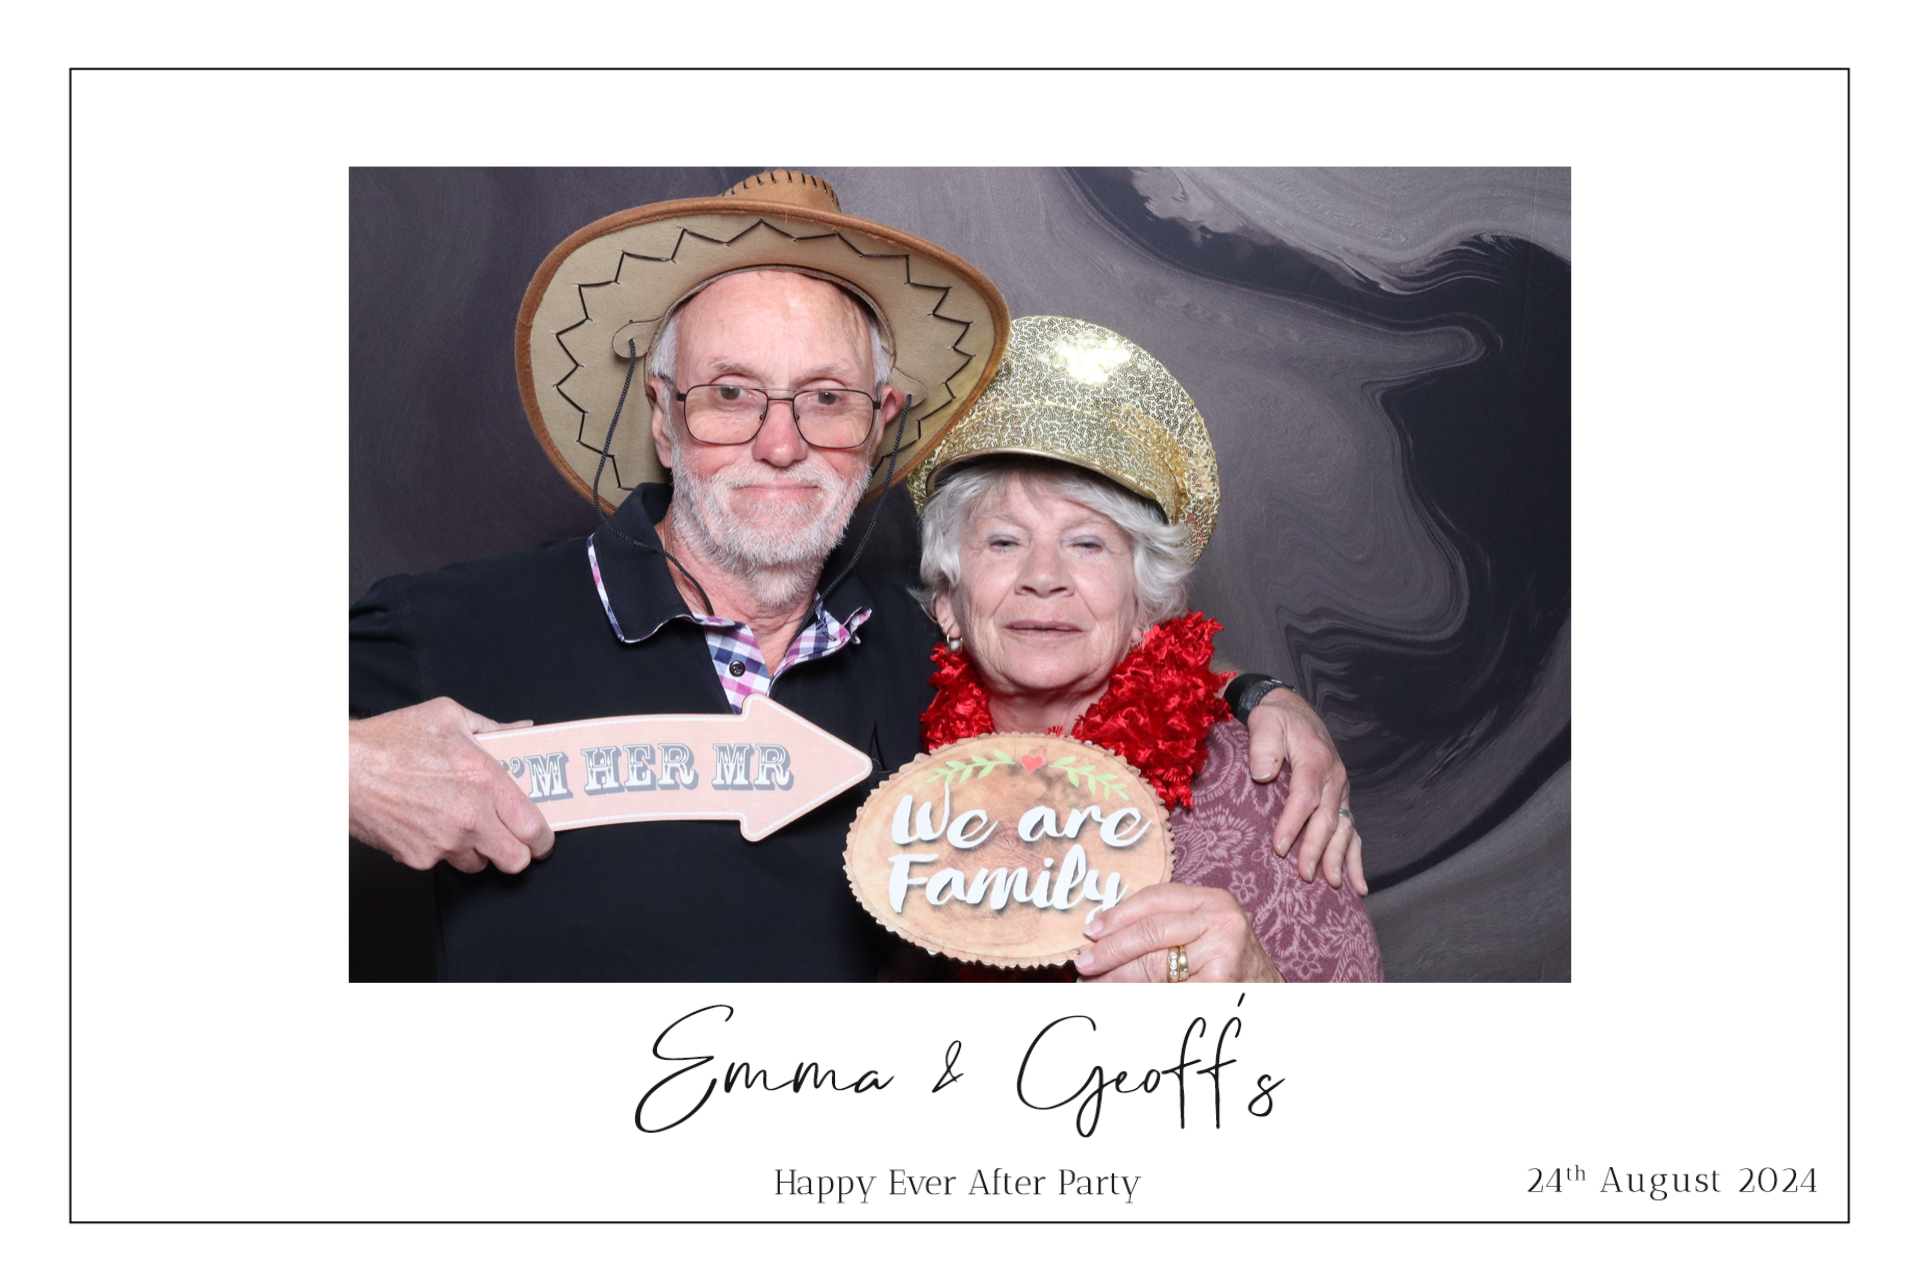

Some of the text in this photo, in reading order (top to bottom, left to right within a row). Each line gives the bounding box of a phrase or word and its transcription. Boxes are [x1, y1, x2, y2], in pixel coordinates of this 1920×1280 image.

[499, 742, 795, 804] 'M HER MR
[891, 781, 1152, 849] We are
[888, 844, 1129, 925] Family
